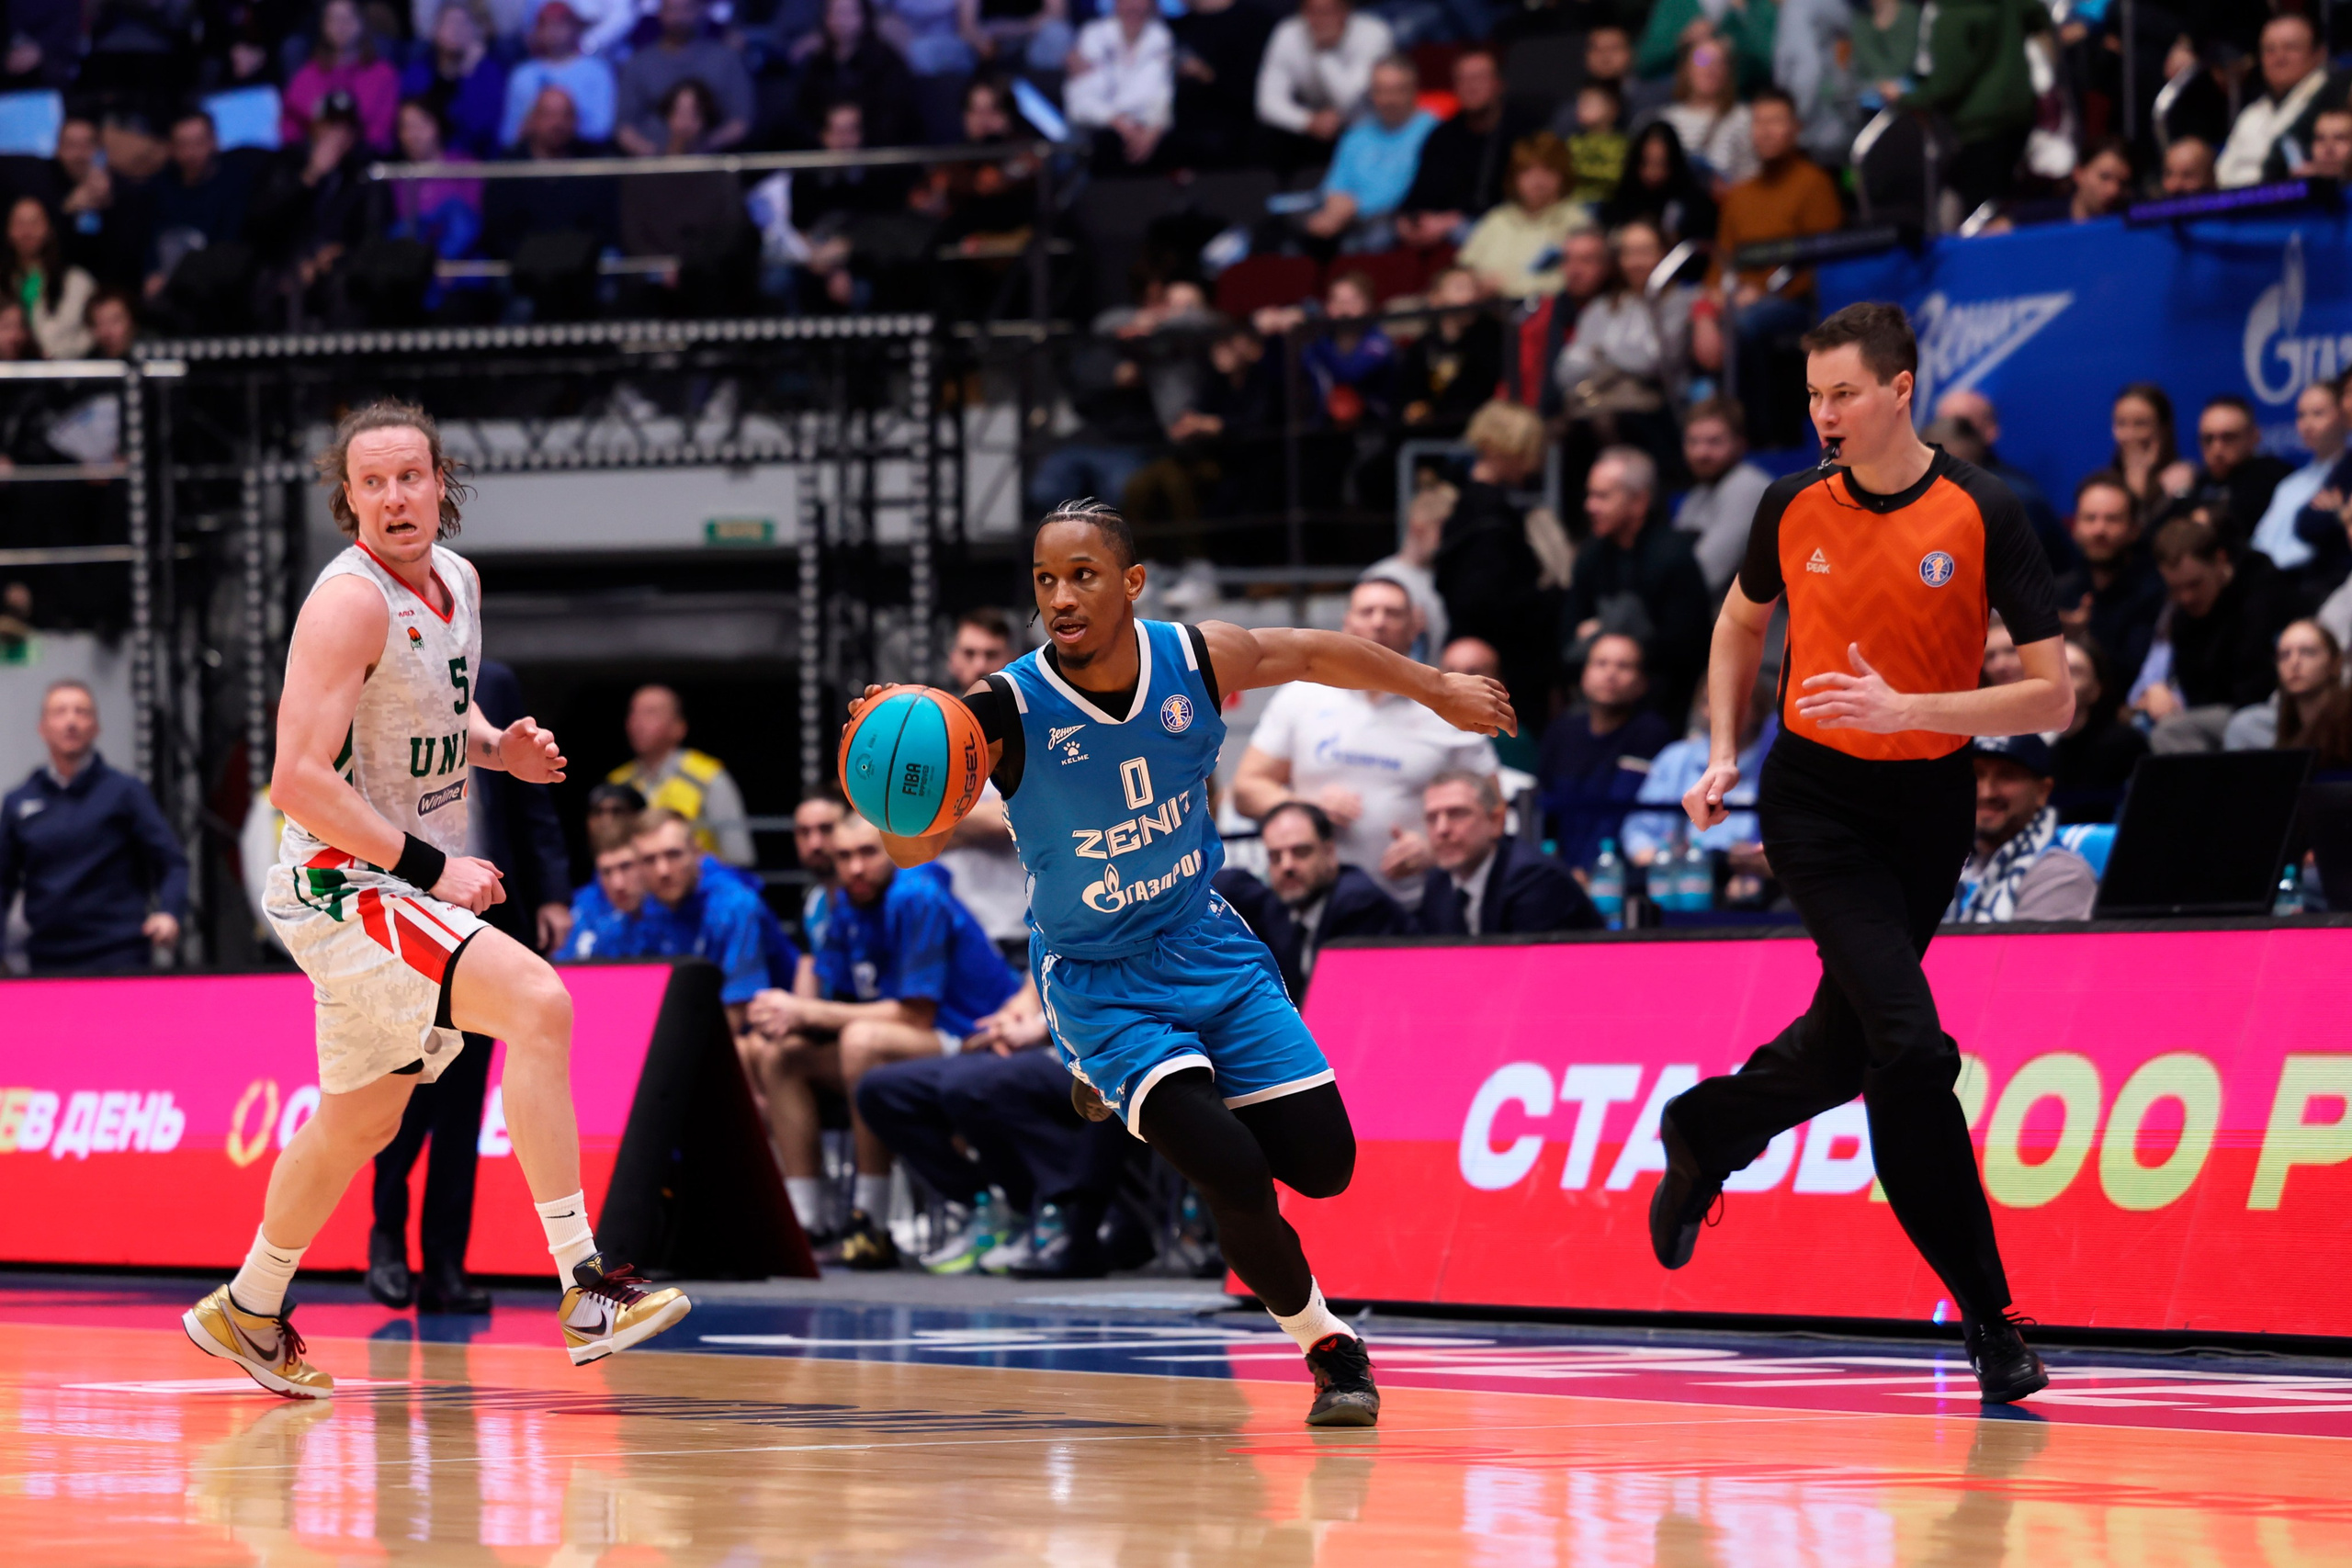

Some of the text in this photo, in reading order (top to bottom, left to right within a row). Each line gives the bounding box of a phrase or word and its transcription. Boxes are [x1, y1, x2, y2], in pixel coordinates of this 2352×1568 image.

[1805, 562, 1830, 574] PEAK
[447, 656, 469, 715] 5
[1060, 753, 1090, 766] KELME
[902, 762, 922, 796] FIBA
[1119, 756, 1154, 810] 0
[420, 786, 460, 812] Winline
[18, 1090, 61, 1152] В
[51, 1090, 186, 1161] ДЕНЬ
